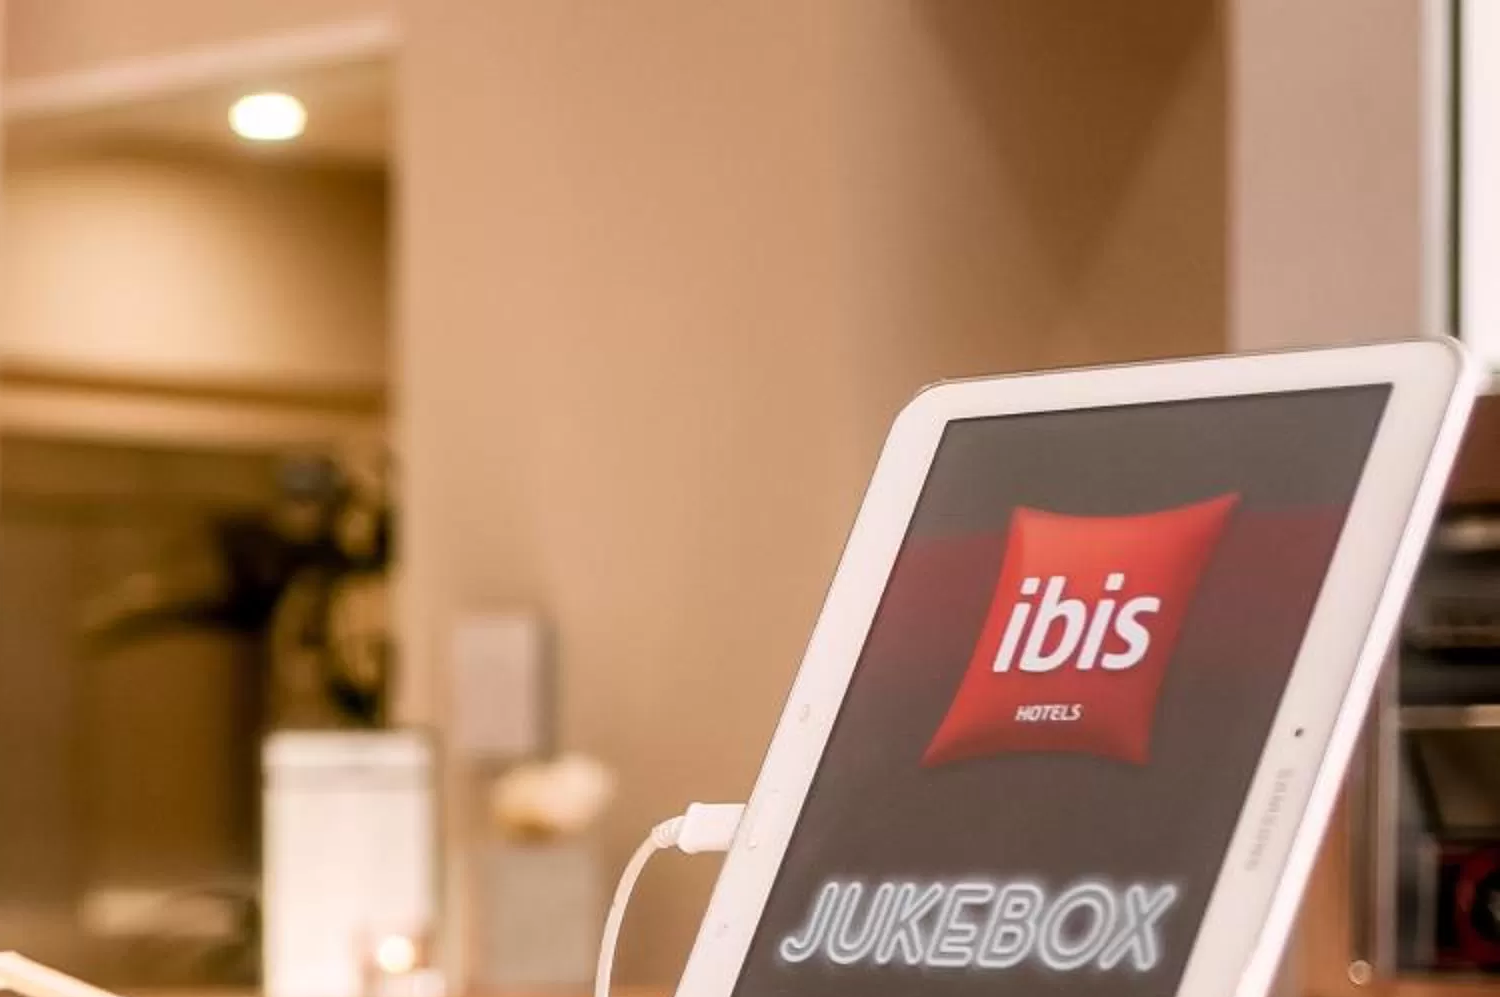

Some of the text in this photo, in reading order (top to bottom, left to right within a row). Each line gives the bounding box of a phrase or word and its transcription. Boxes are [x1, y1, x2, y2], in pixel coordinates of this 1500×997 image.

[992, 573, 1160, 673] ibis
[1015, 704, 1083, 722] HOTELS
[779, 880, 1177, 971] JUKEBOX
